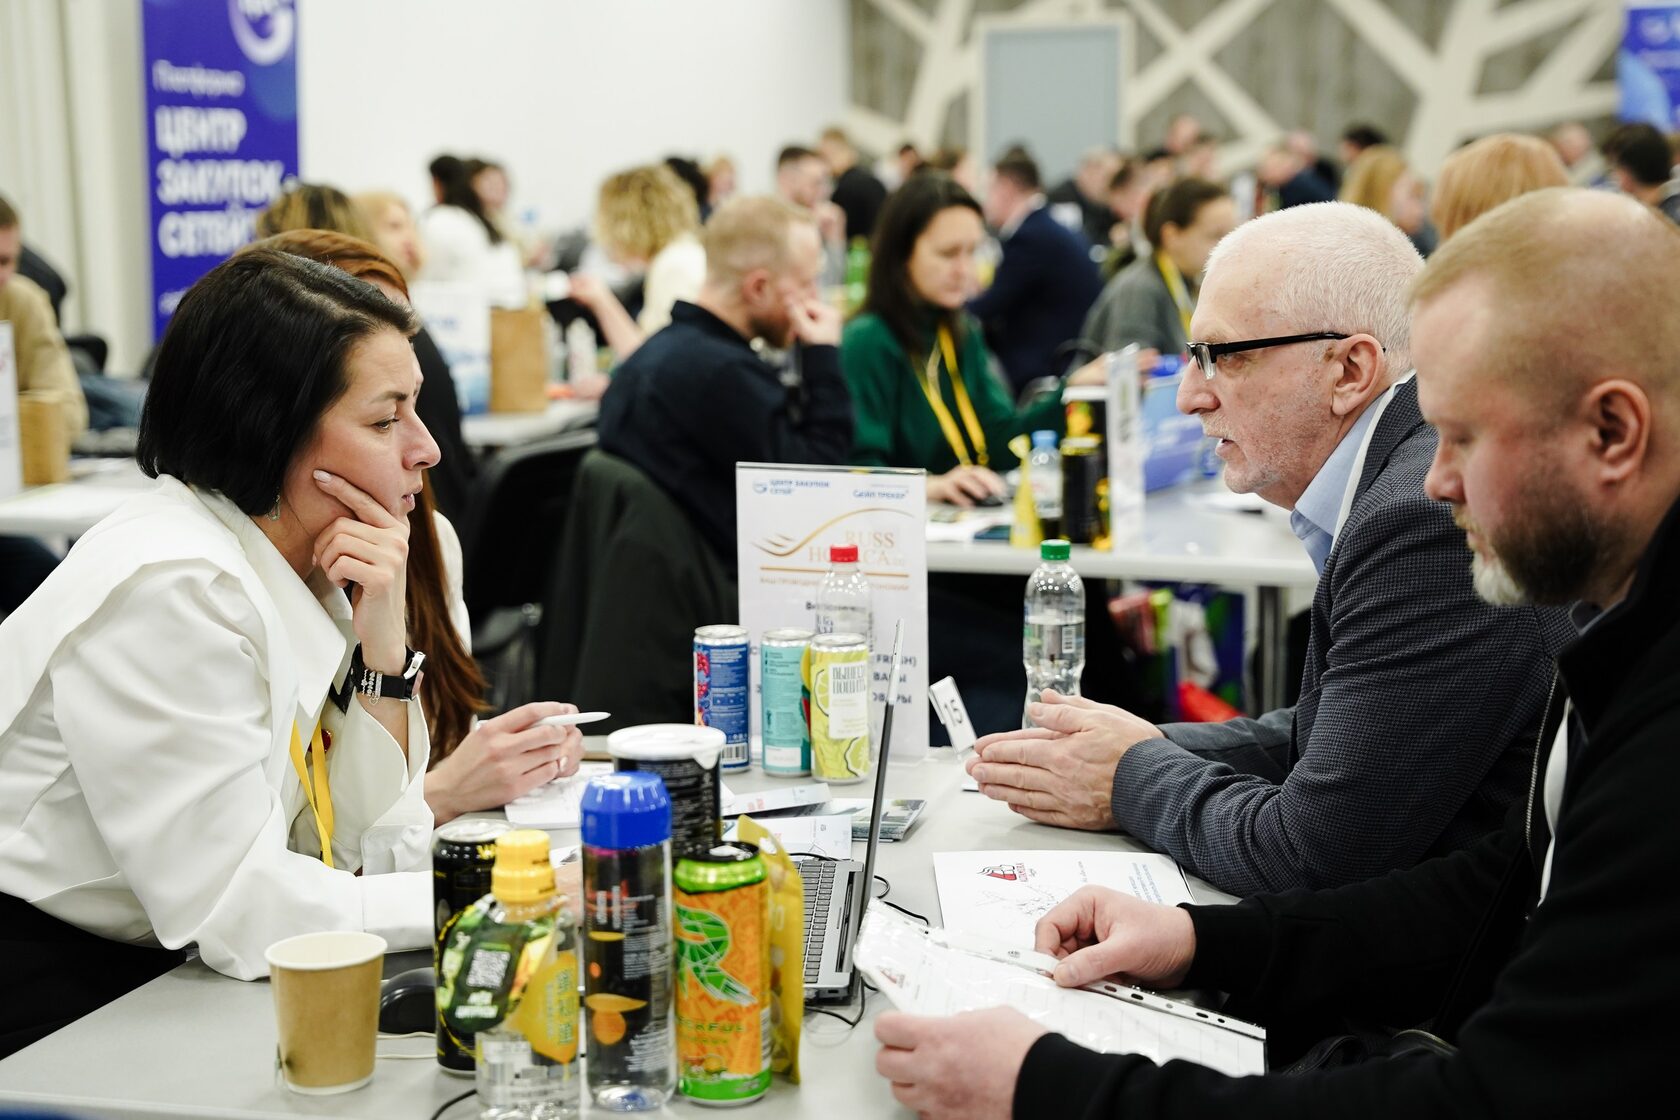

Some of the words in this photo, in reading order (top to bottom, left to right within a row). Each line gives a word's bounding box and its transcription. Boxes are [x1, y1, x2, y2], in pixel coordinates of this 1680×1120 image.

[155, 105, 248, 157] ЦЕНТР
[156, 159, 284, 205] ЗАКУПОК
[845, 531, 894, 549] RUSS
[944, 699, 963, 726] 15
